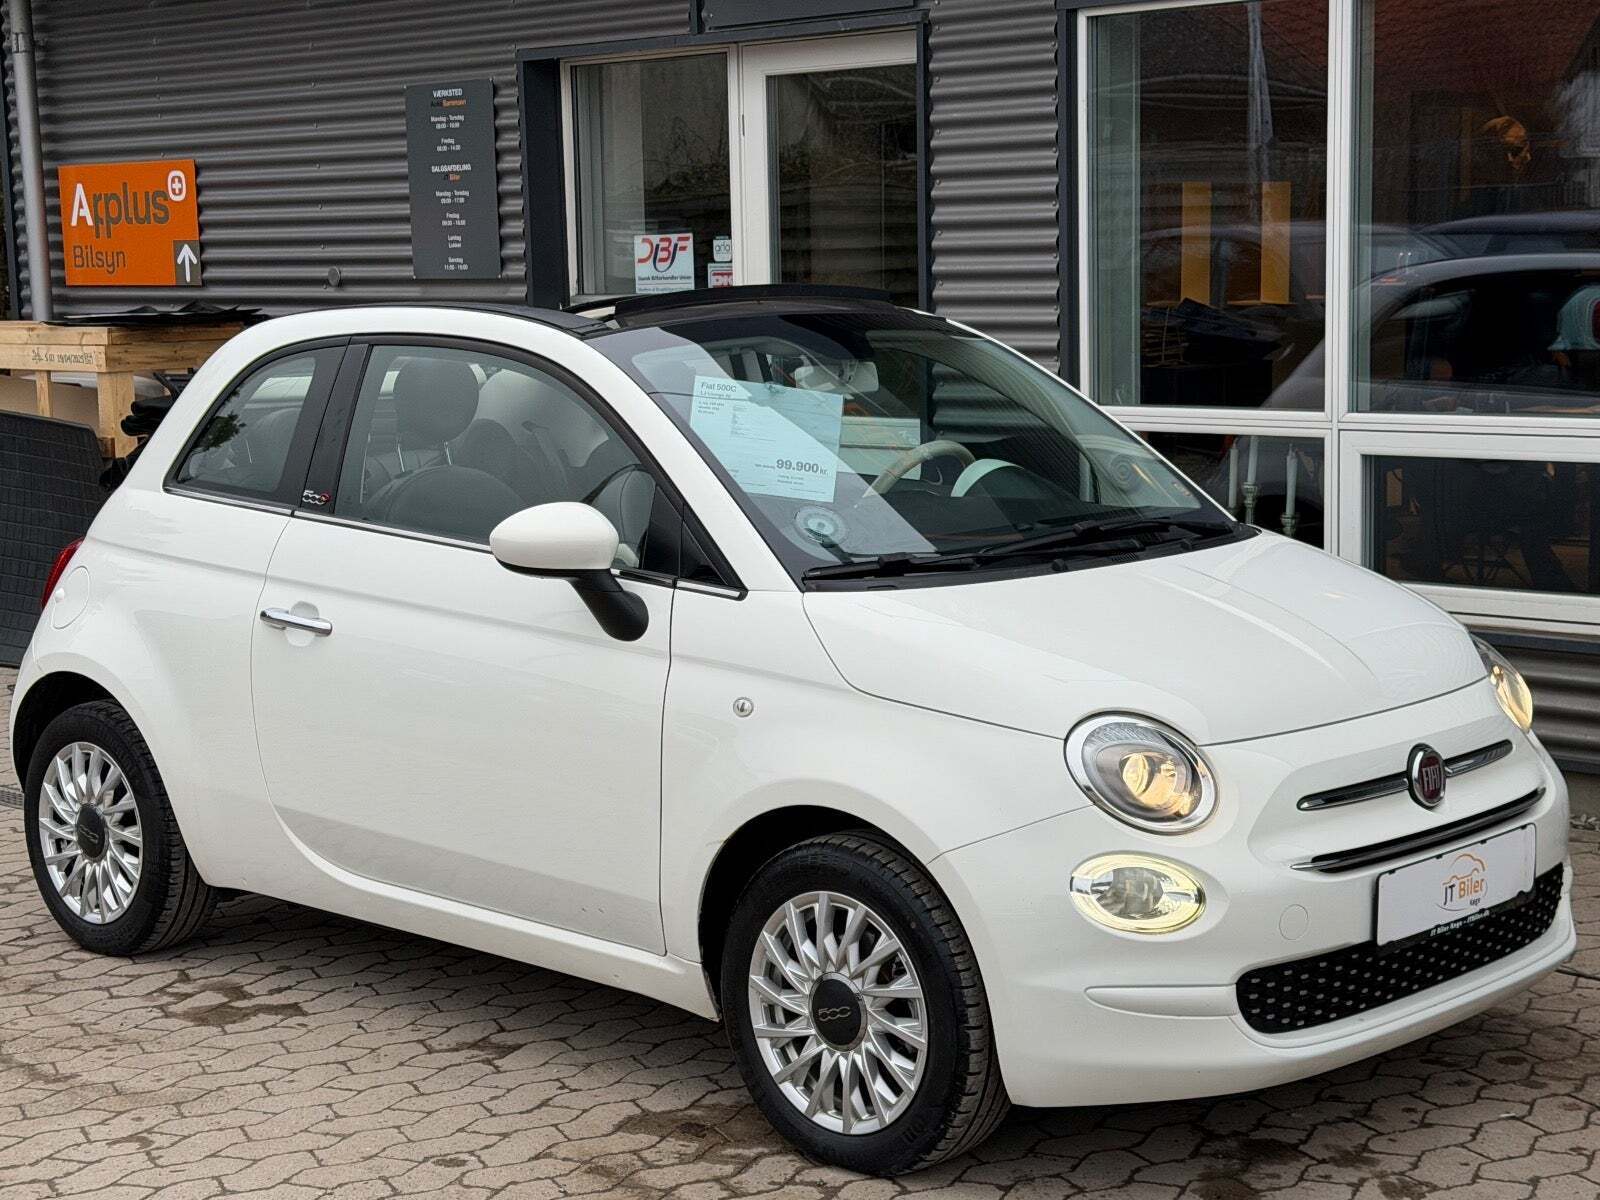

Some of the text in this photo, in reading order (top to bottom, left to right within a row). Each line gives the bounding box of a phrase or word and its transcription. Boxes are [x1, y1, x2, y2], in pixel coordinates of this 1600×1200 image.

[433, 88, 462, 97] VÆRKSTED
[431, 164, 472, 173] SALGSAFDELING
[73, 245, 126, 274] Bilsyn
[701, 382, 737, 393] Fiat 500C
[776, 459, 820, 474] 99.900
[1421, 765, 1441, 793] FIAT
[1458, 877, 1485, 899] Biler
[818, 1006, 852, 1022] 500
